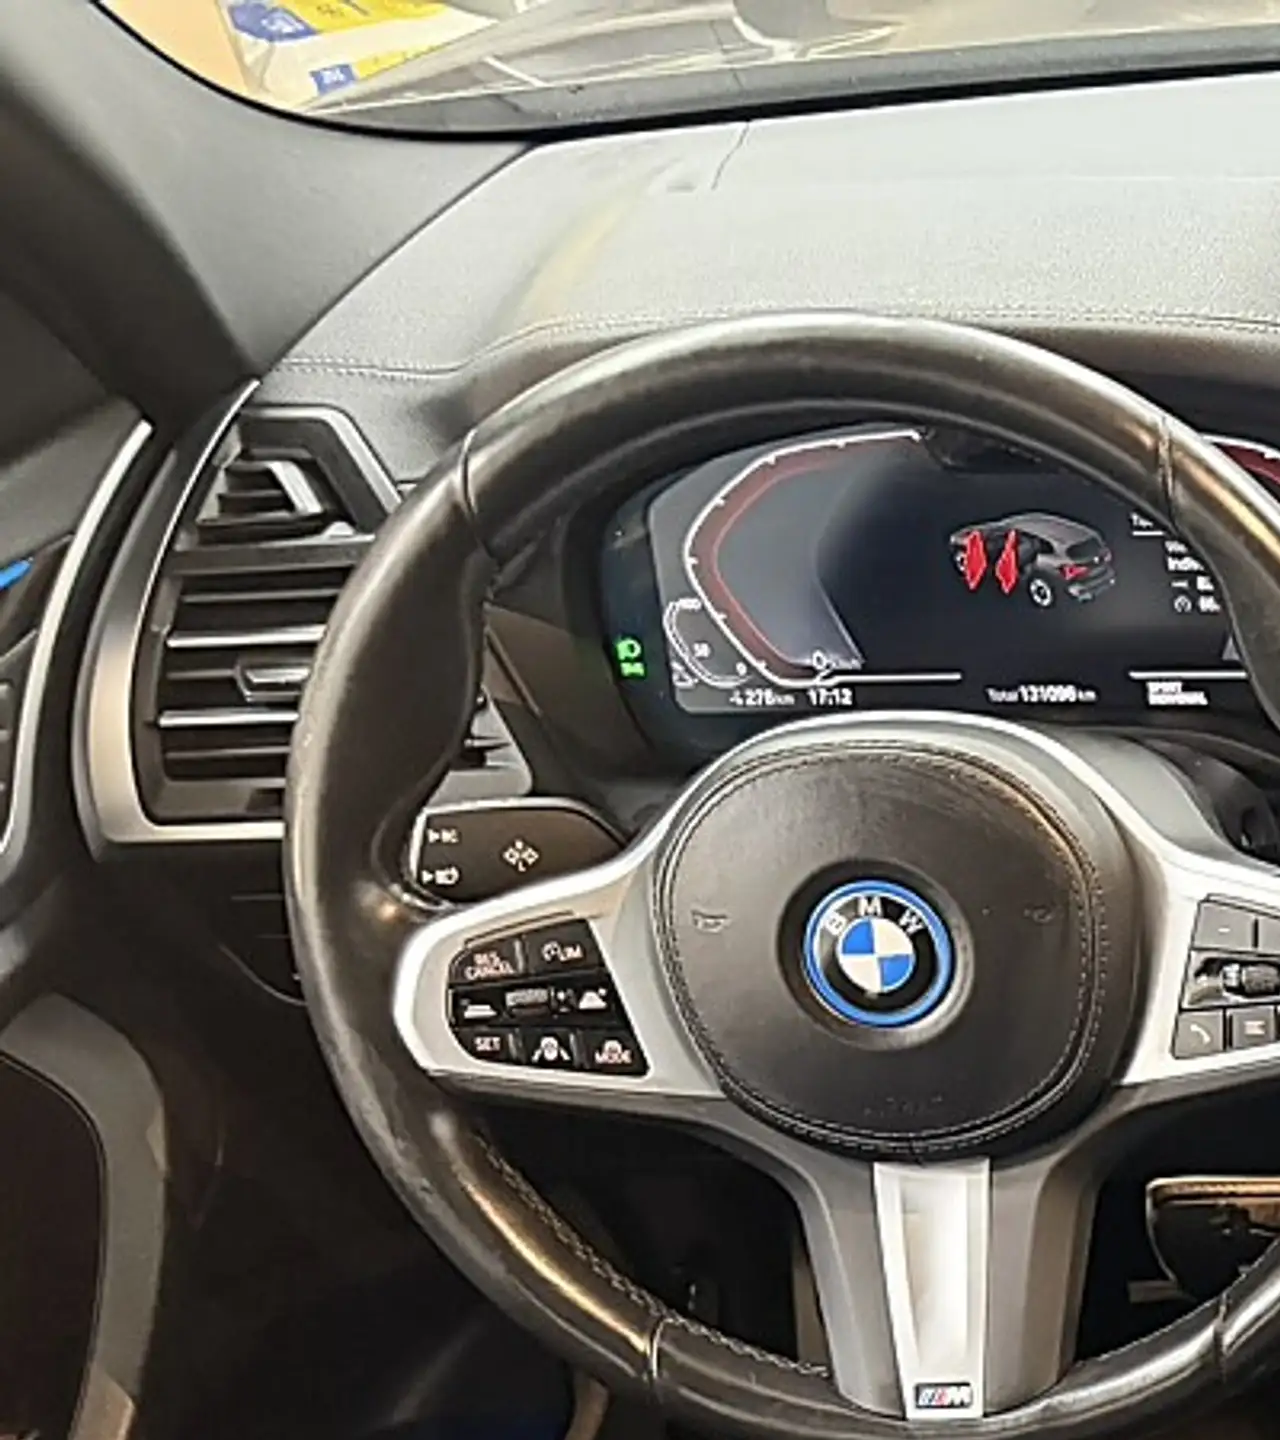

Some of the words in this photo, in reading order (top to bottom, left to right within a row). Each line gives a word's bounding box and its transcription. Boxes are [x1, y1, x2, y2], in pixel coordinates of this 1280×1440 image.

[806, 687, 854, 707] 17:12
[823, 895, 924, 936] BMW
[463, 960, 515, 981] CANCEL
[474, 1036, 501, 1051] SET
[594, 1050, 633, 1064] MODE
